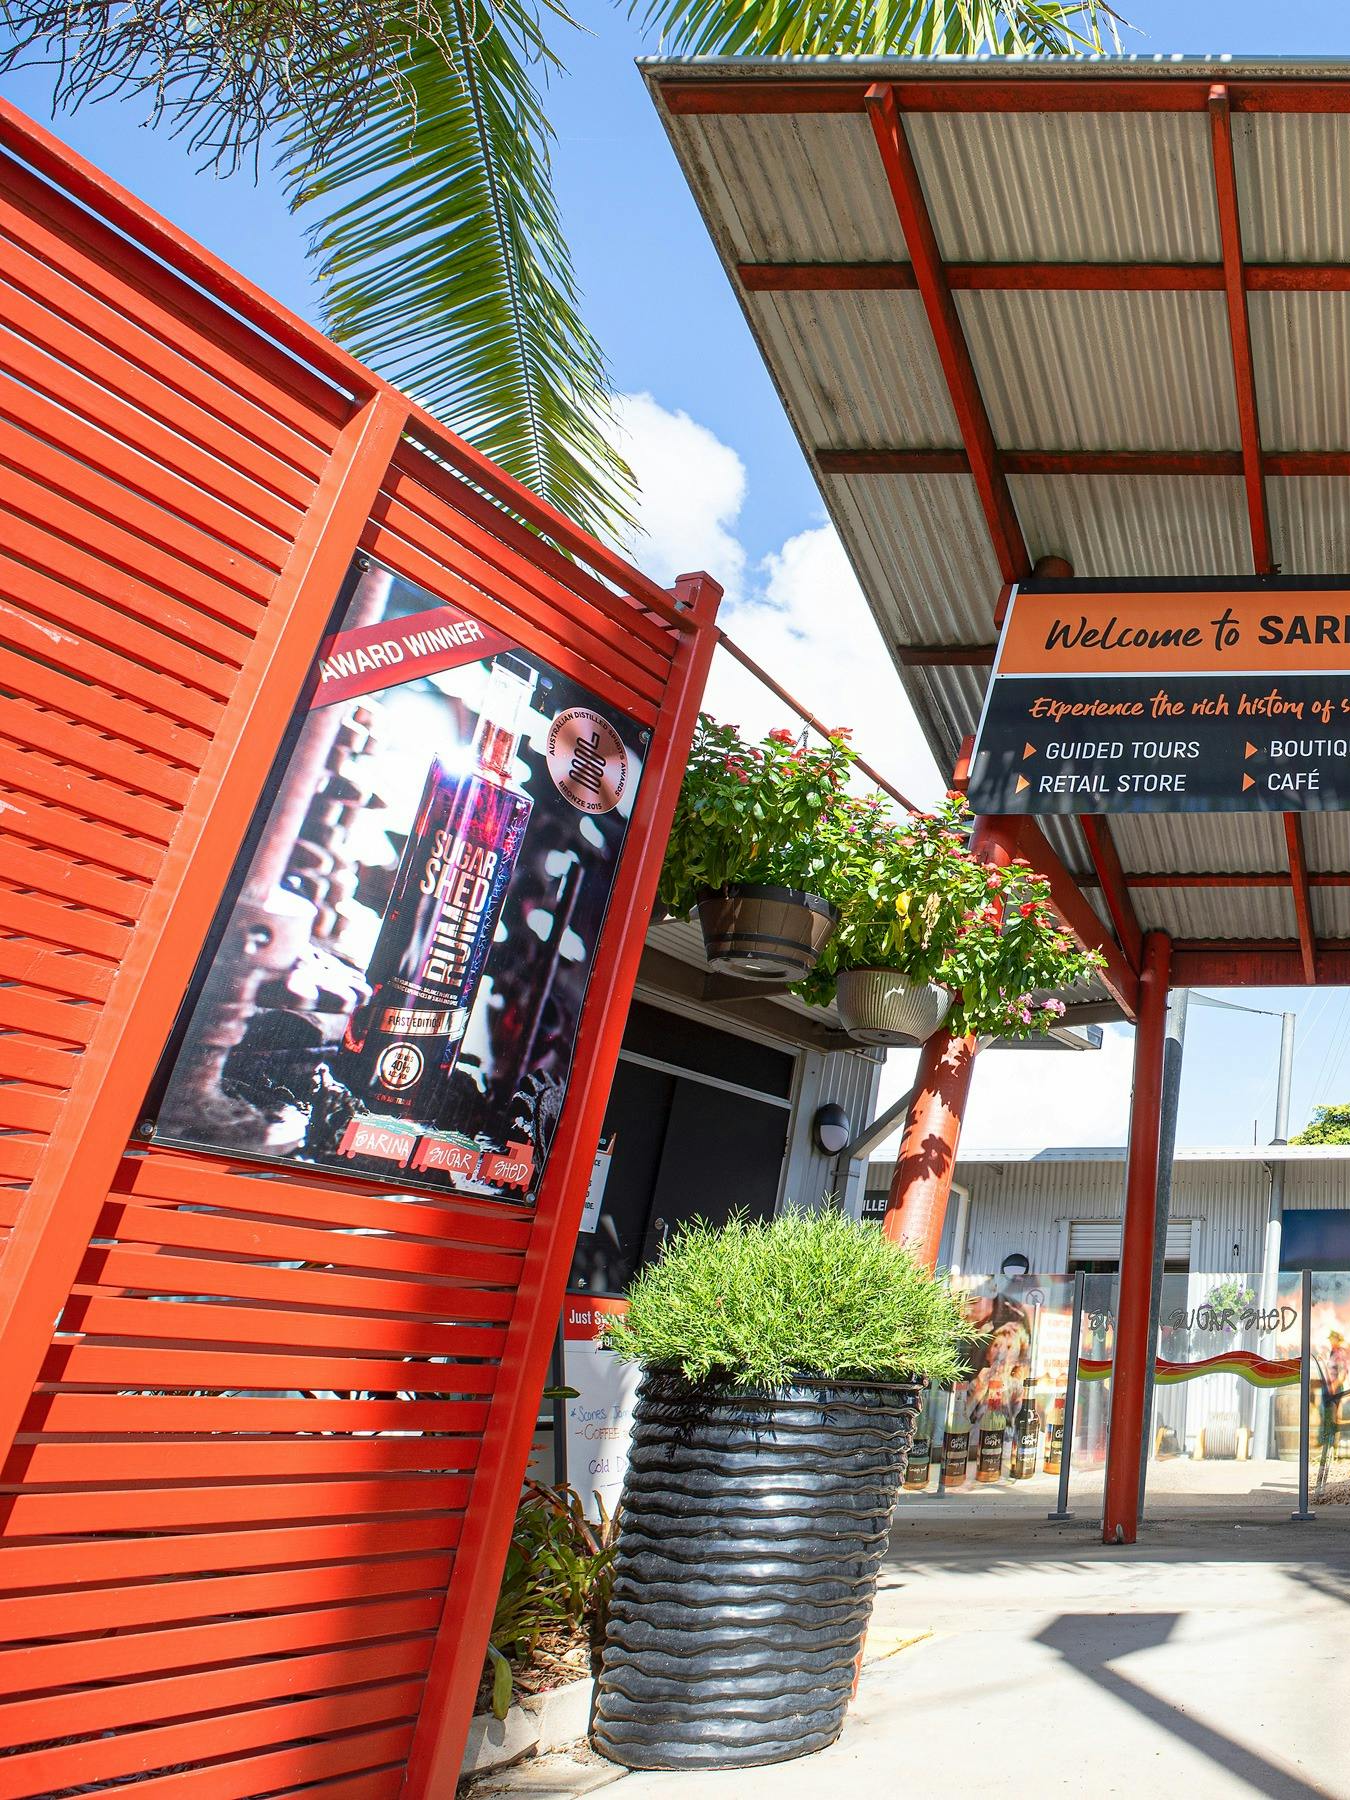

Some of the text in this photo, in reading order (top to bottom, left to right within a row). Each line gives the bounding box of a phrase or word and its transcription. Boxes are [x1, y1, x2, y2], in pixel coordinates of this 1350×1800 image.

[1044, 616, 1204, 650] Welcome
[1210, 607, 1240, 651] to
[318, 619, 485, 684] AWARD WINNER
[1028, 697, 1145, 723] Experience
[1150, 689, 1185, 719] the
[1191, 693, 1229, 716] rich
[1237, 688, 1304, 720] history
[1311, 698, 1336, 723] of
[549, 711, 627, 797] AUSTRALIAN DISTILLED SPIRITS AWARDS
[1045, 740, 1200, 760] GUIDED TOURS
[1038, 774, 1187, 793] RETAIL STORE
[1266, 768, 1320, 791] CAFÉ
[558, 780, 602, 810] BRONZE 2015
[431, 829, 498, 879] SUGAR
[419, 857, 490, 913] SHED
[422, 903, 481, 987] RUM
[429, 1146, 473, 1170] SUGAR
[569, 1308, 592, 1326] Just
[1168, 1303, 1237, 1332] SUGAR
[578, 1406, 607, 1422] Scones
[588, 1459, 609, 1475] Cold
